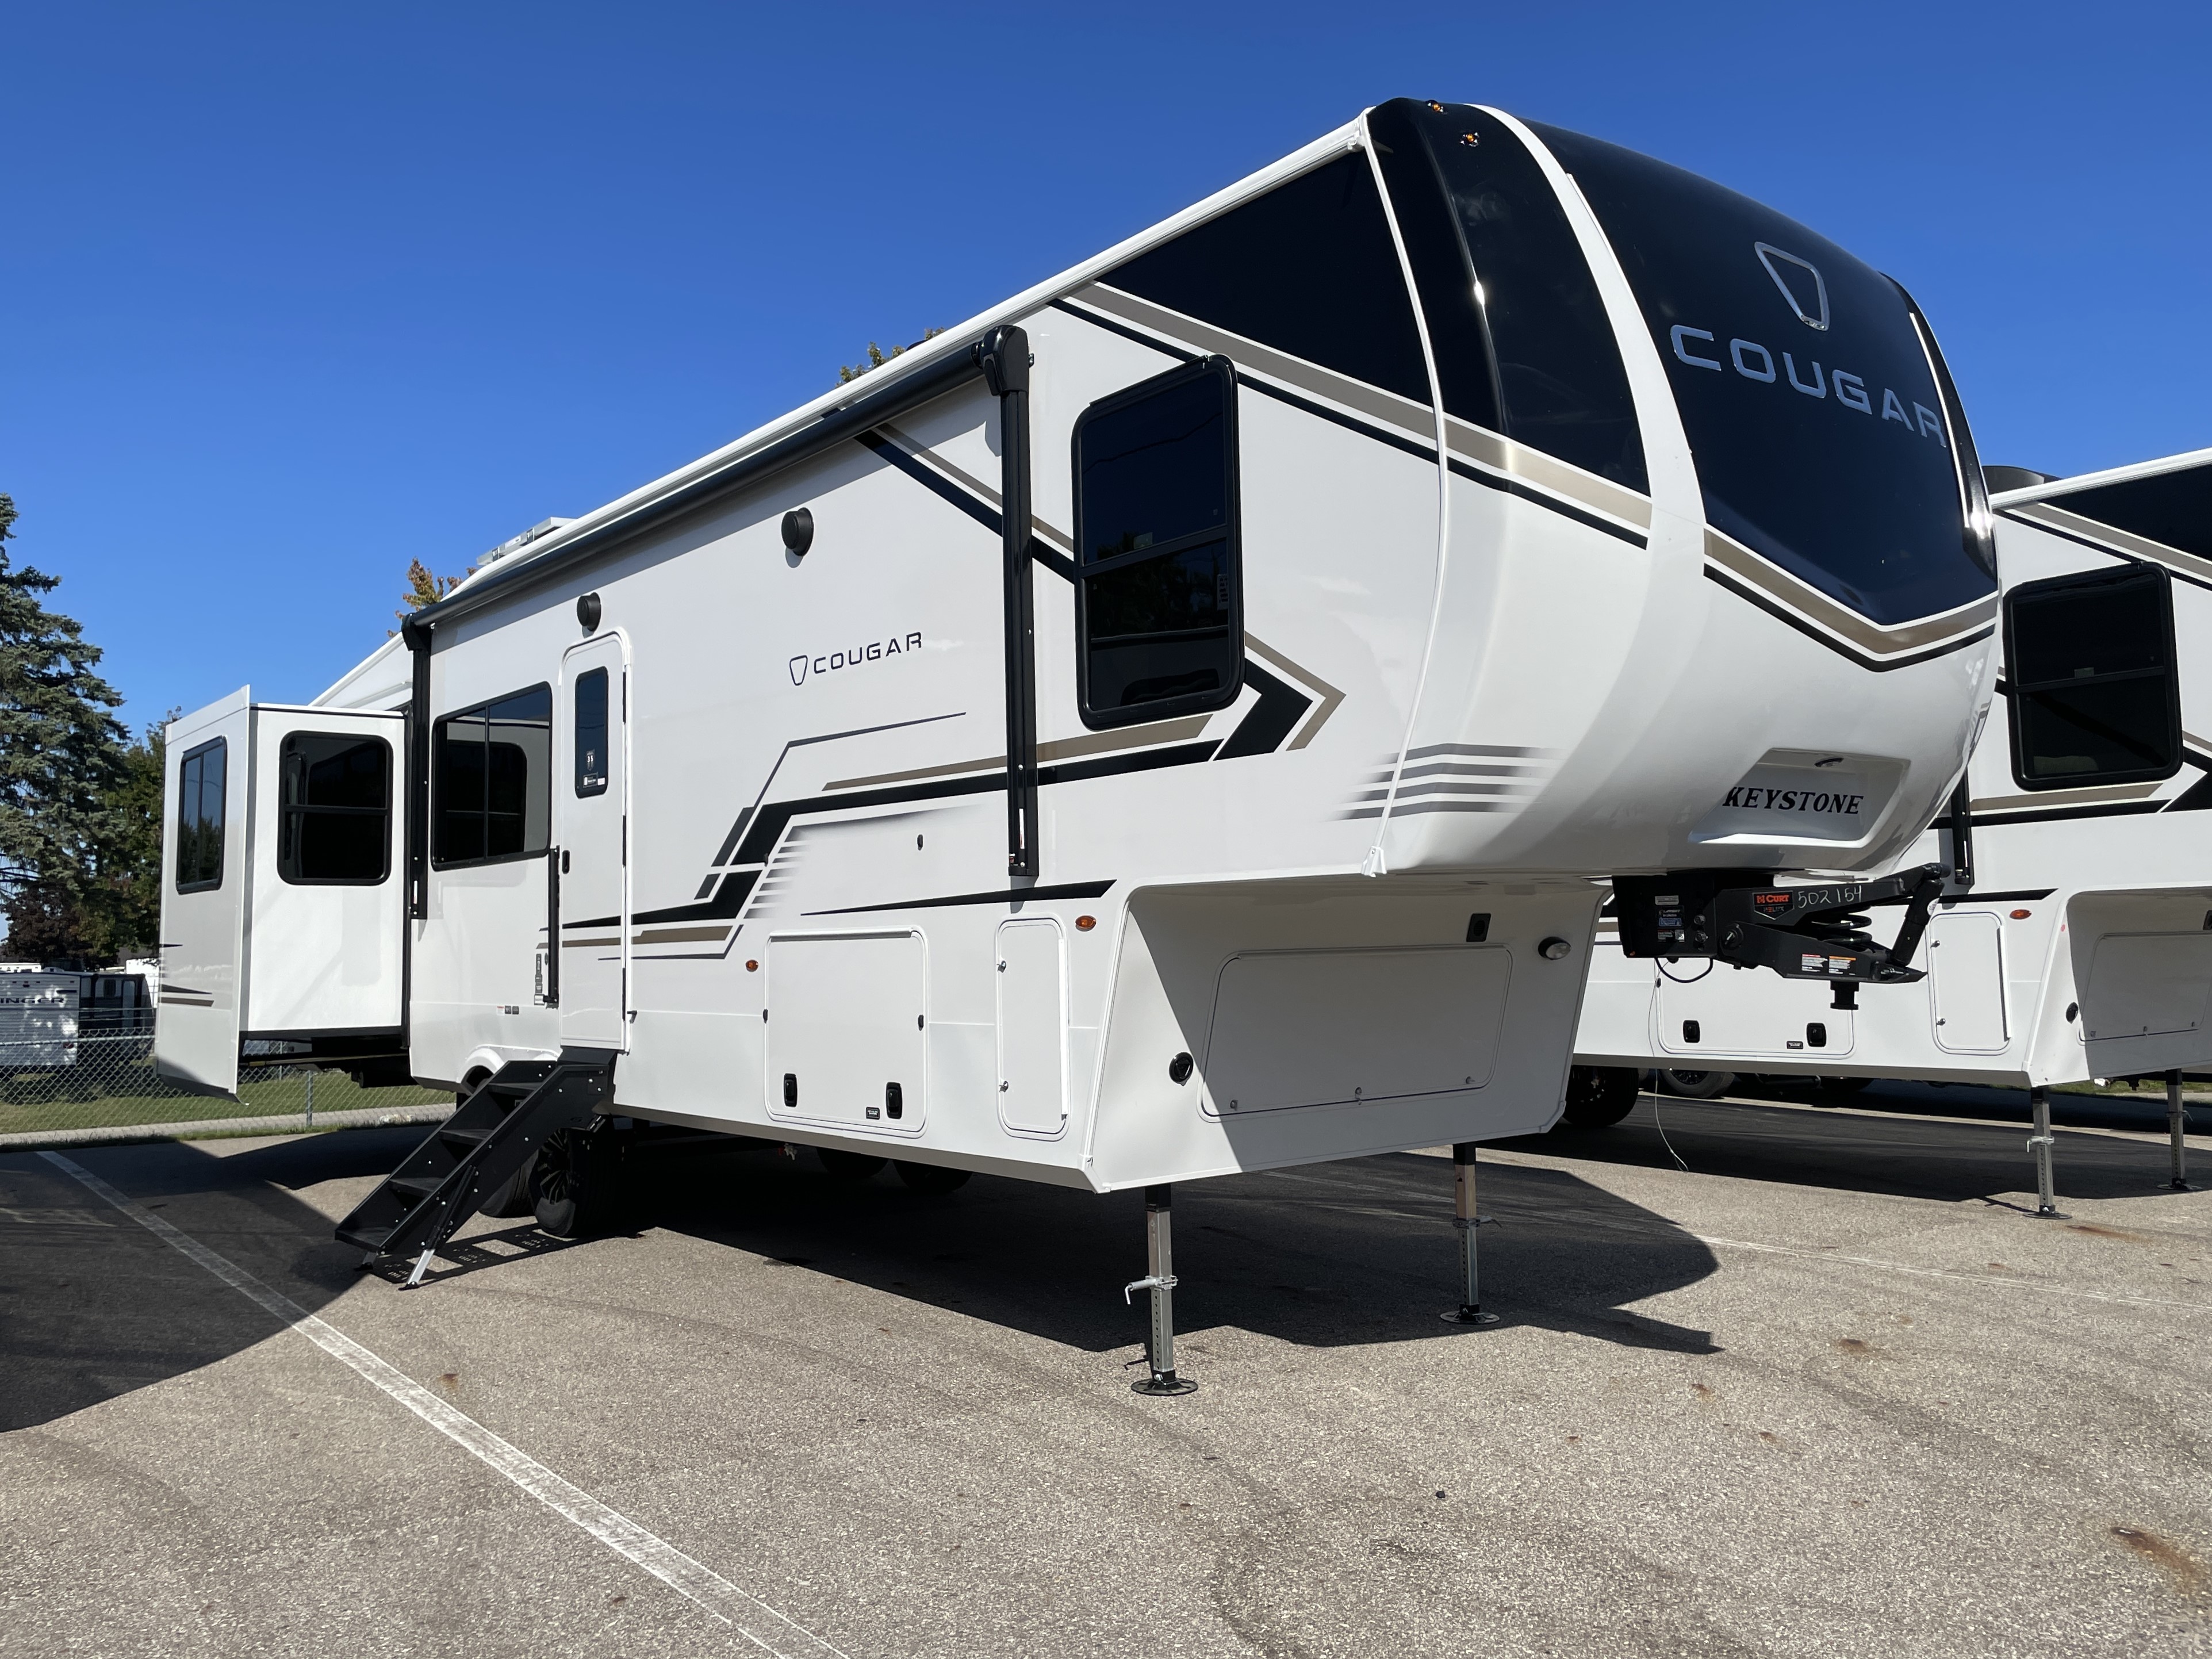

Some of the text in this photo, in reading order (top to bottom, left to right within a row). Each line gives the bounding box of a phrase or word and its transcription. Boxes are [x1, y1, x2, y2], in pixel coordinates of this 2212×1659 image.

[1670, 324, 1946, 447] COUGAR
[814, 631, 922, 674] COUGAR
[1722, 786, 1864, 815] KEYSTONE
